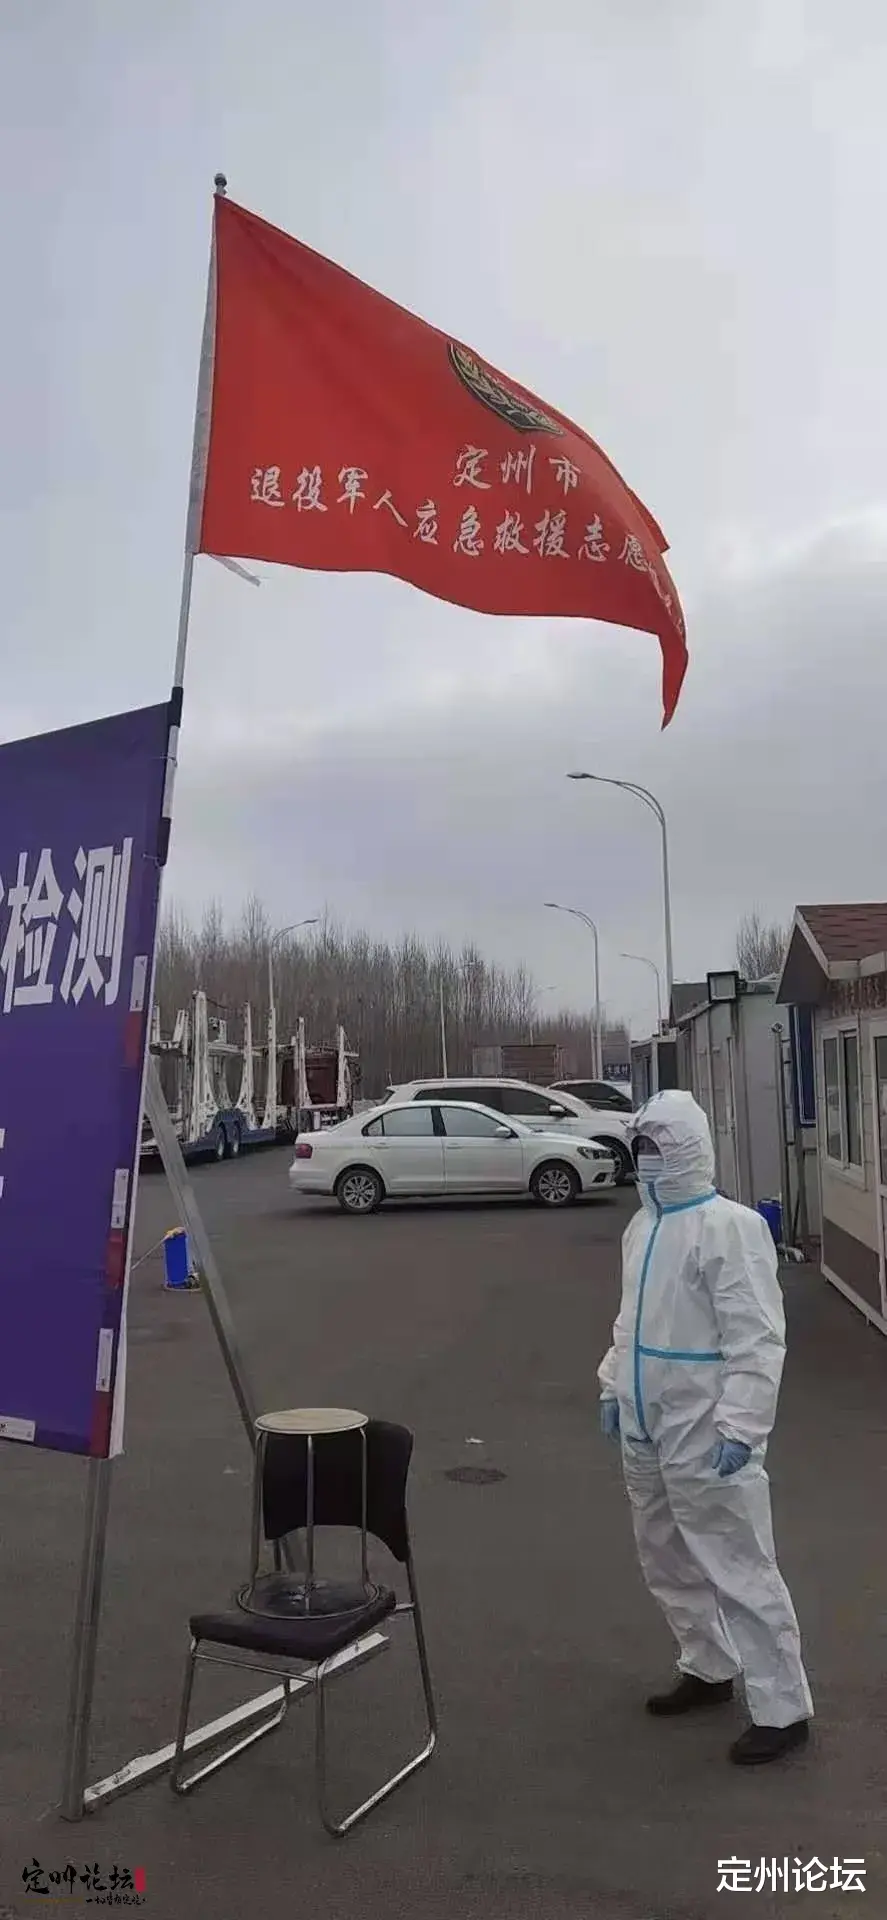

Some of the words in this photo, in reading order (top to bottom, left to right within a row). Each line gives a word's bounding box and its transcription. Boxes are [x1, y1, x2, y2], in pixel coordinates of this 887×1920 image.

[249, 464, 684, 636] 退役军人应急救援志愿
[452, 443, 582, 495] 定州市
[0, 836, 134, 1014] 检测
